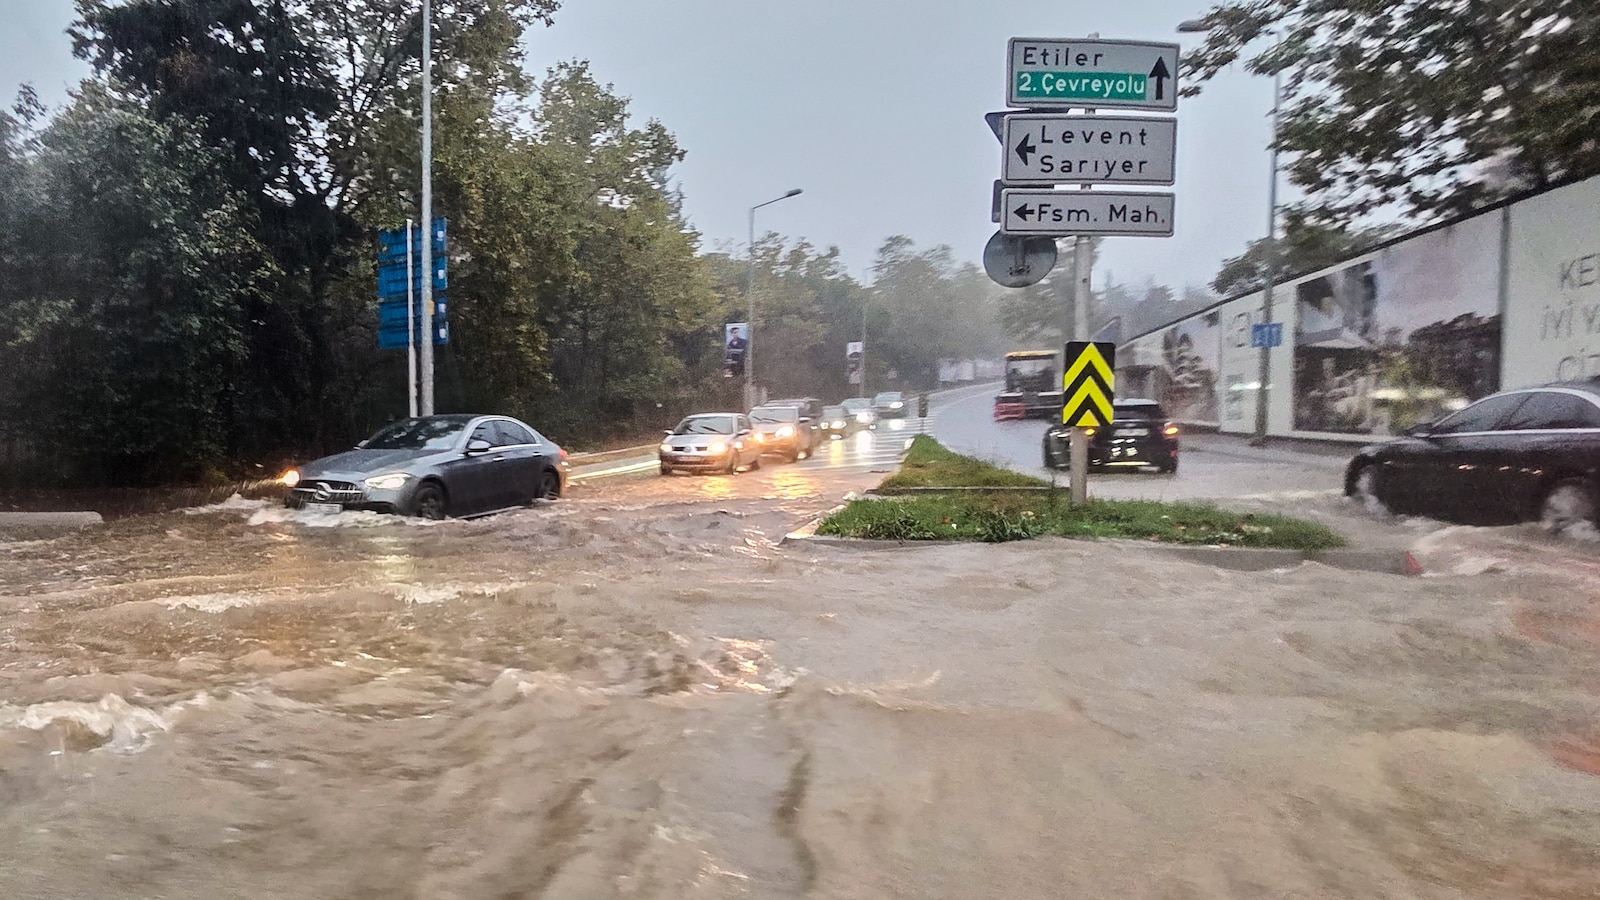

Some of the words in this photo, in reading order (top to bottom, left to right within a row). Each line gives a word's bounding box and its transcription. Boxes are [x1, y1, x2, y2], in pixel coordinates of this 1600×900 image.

[1023, 46, 1104, 67] Etiler
[1018, 73, 1037, 92] 2.
[1041, 73, 1146, 98] Çevreyolu
[1040, 125, 1148, 146] Levent
[1039, 154, 1148, 179] Sarıyer
[1037, 203, 1098, 222] Fsm.
[1108, 203, 1166, 224] Mah.
[1558, 252, 1600, 290] KE
